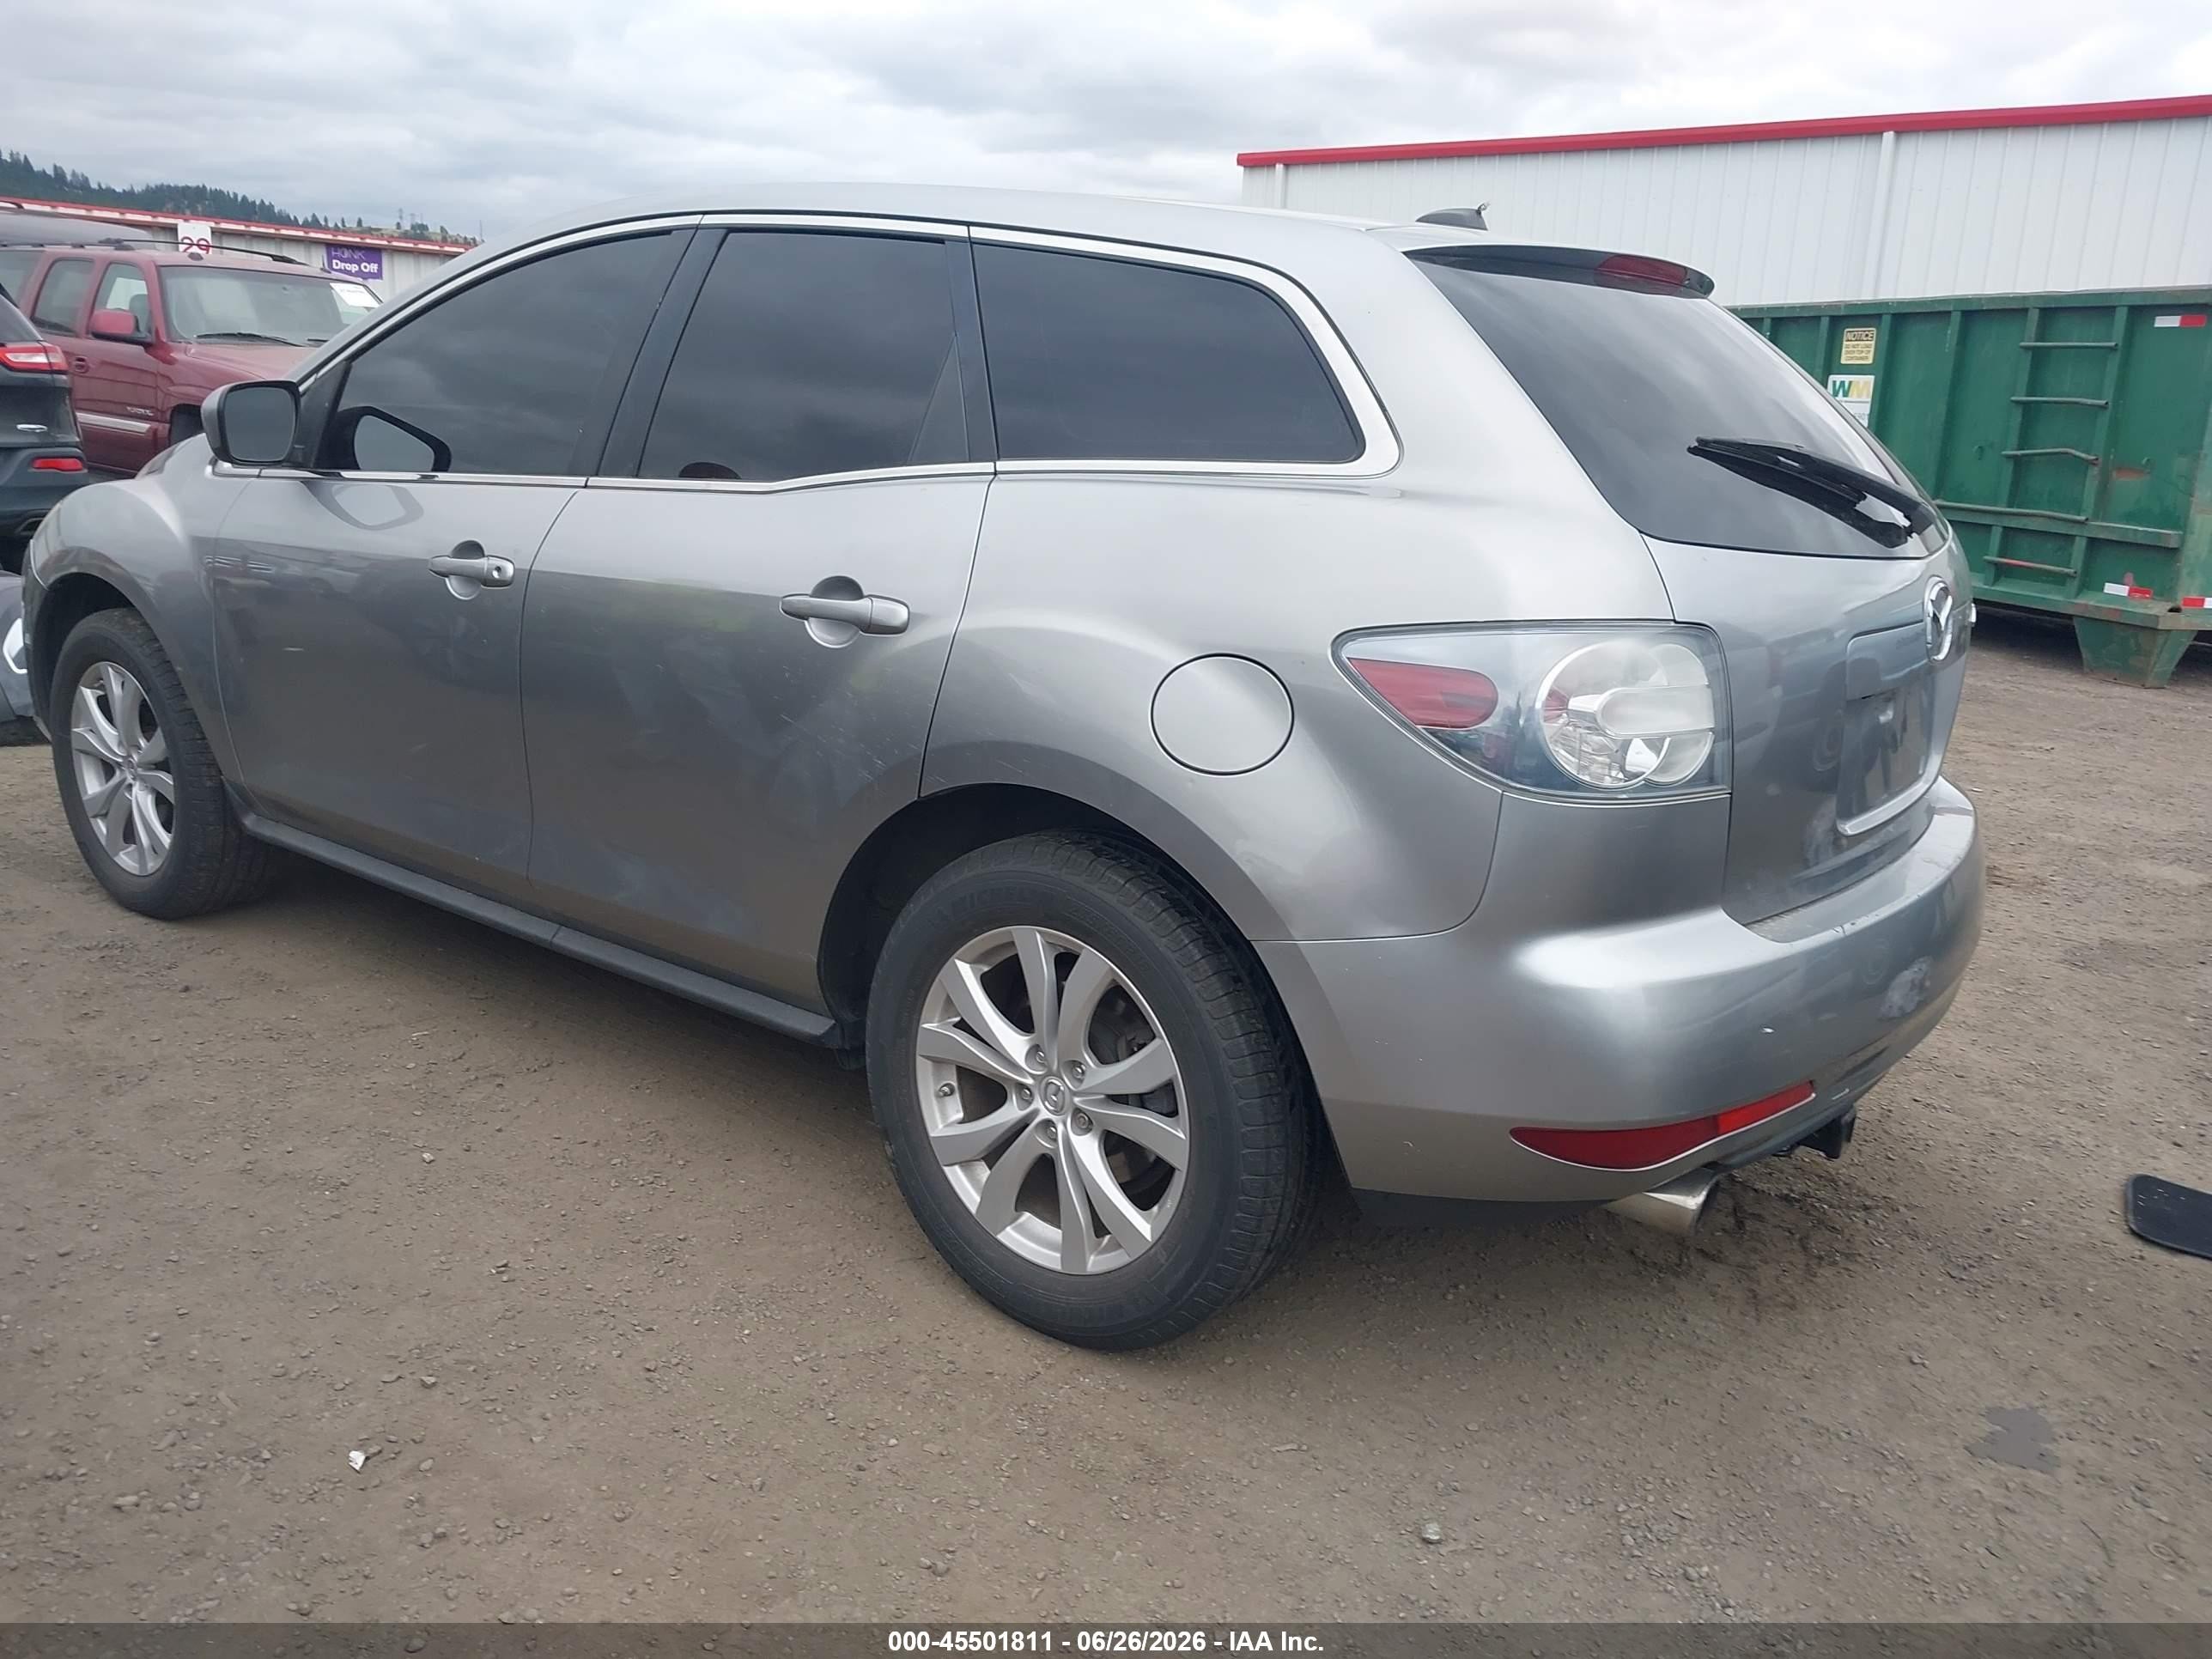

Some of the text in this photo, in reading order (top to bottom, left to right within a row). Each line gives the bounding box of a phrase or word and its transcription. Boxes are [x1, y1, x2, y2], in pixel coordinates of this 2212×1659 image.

[332, 259, 379, 273] Drop Off
[1846, 331, 1875, 341] NOTICE
[1832, 380, 1871, 398] WM
